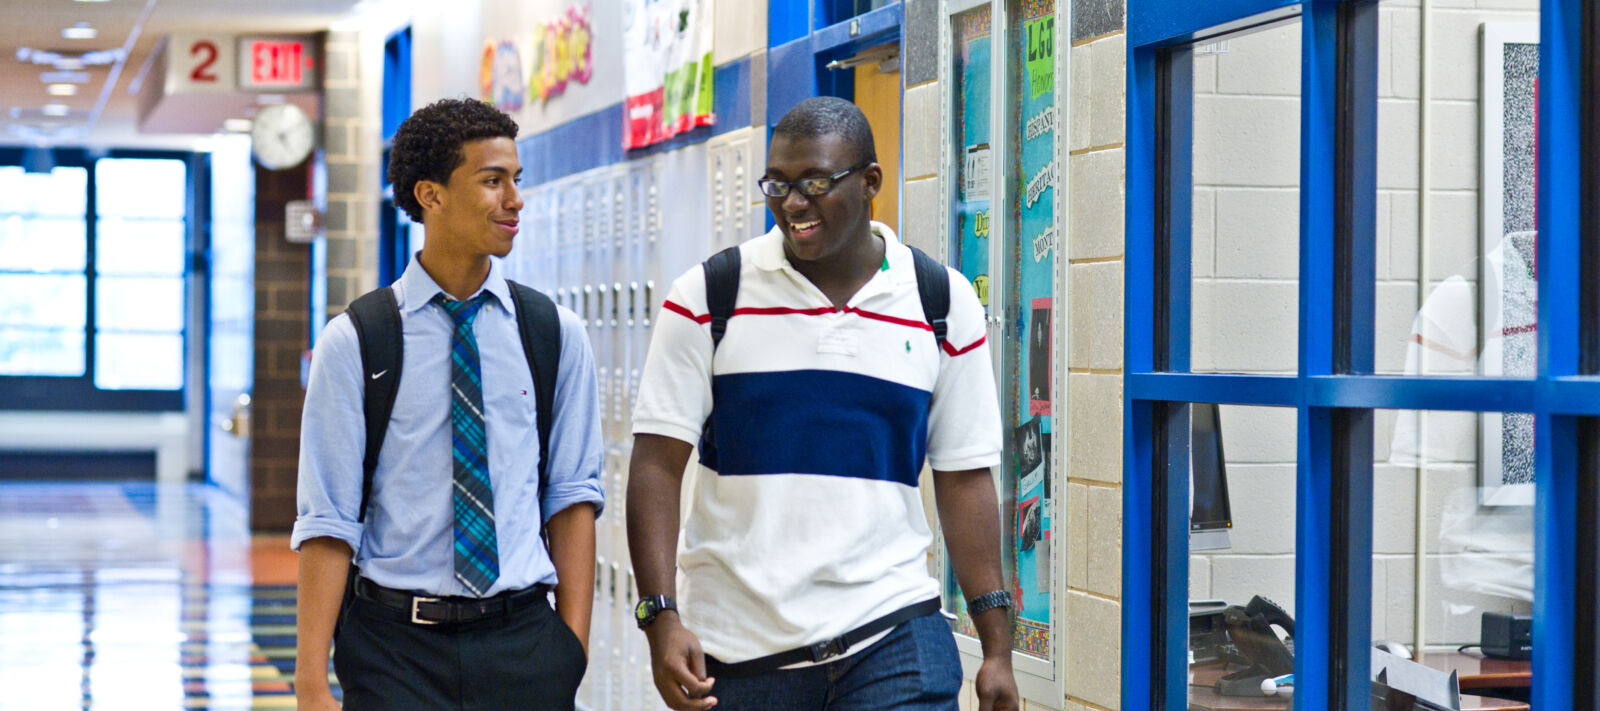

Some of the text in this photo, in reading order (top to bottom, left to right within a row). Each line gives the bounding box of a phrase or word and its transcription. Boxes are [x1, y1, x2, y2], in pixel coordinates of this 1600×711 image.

[190, 40, 217, 81] 2
[252, 40, 303, 84] EXIT
[1027, 112, 1054, 138] HISPANI
